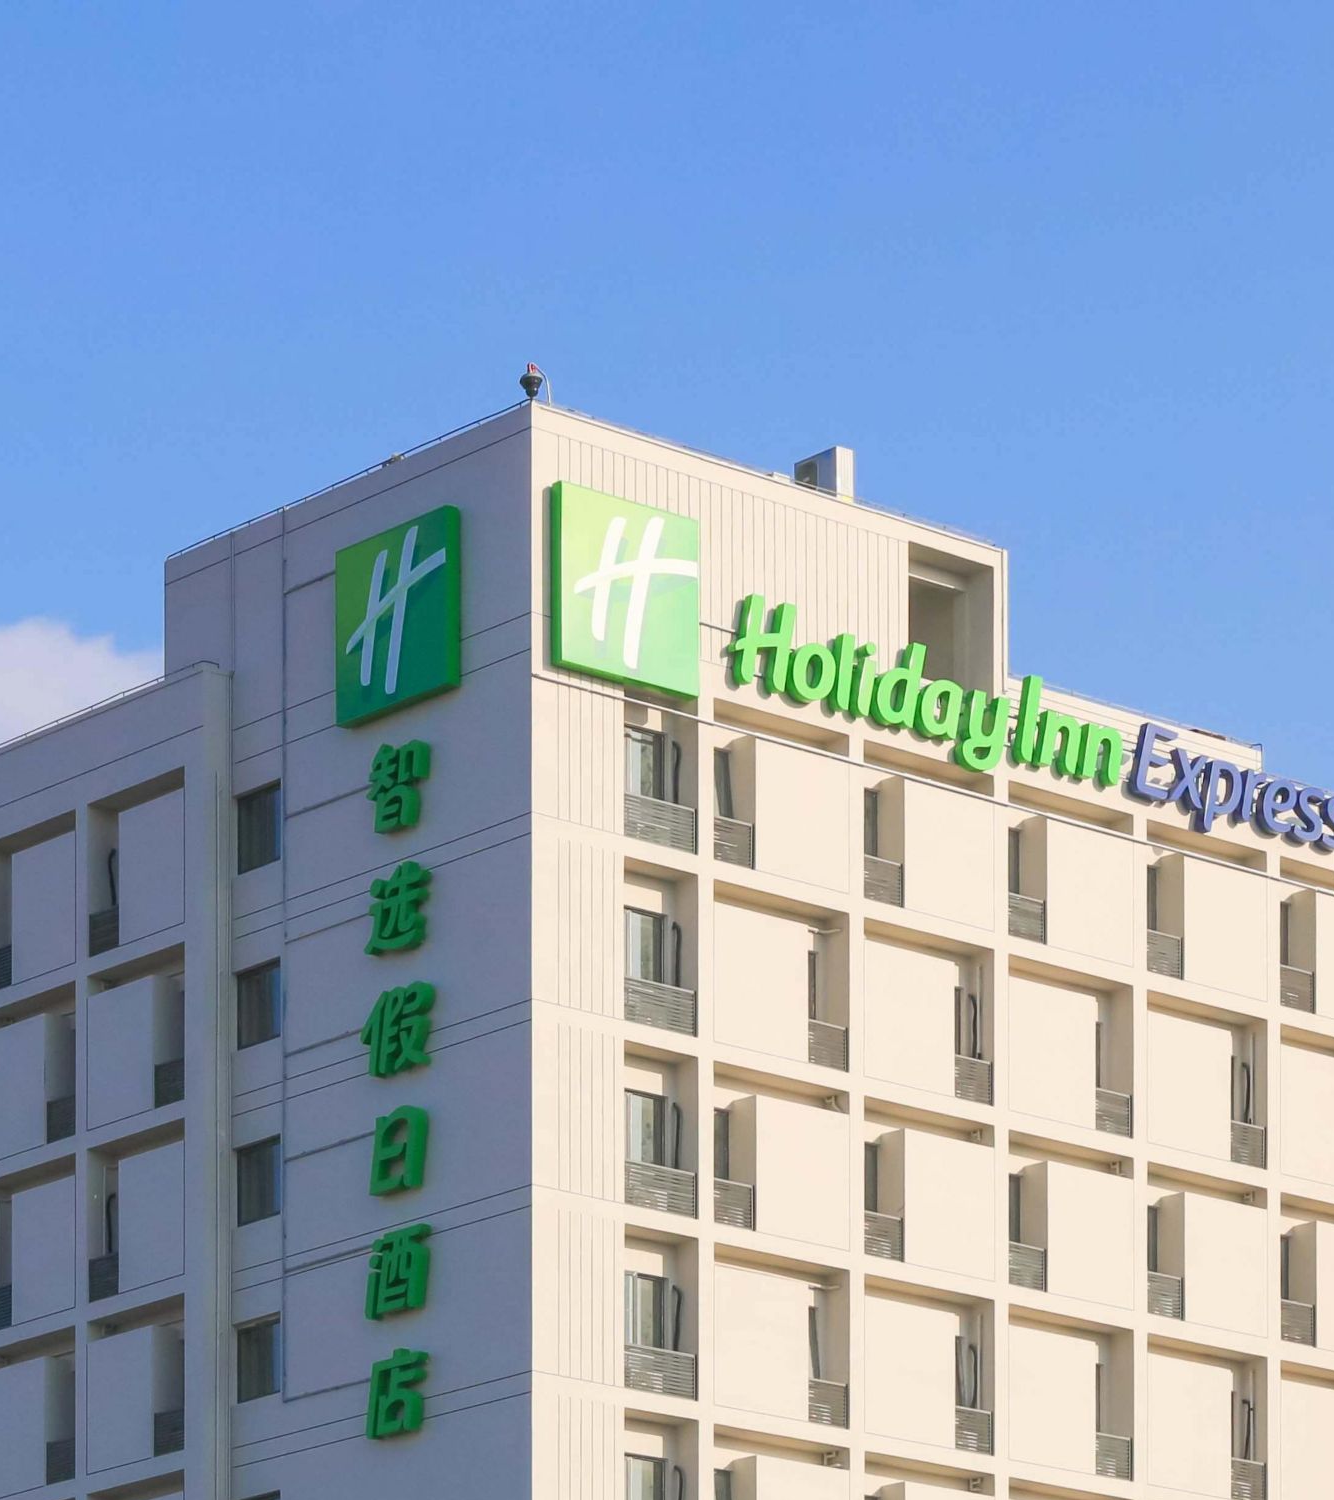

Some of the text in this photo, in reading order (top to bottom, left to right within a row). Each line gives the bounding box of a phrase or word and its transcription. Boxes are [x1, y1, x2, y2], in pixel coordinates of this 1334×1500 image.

[728, 593, 1011, 772] Holiday
[1012, 674, 1124, 787] Inn
[360, 737, 437, 1441] 智选假日酒店
